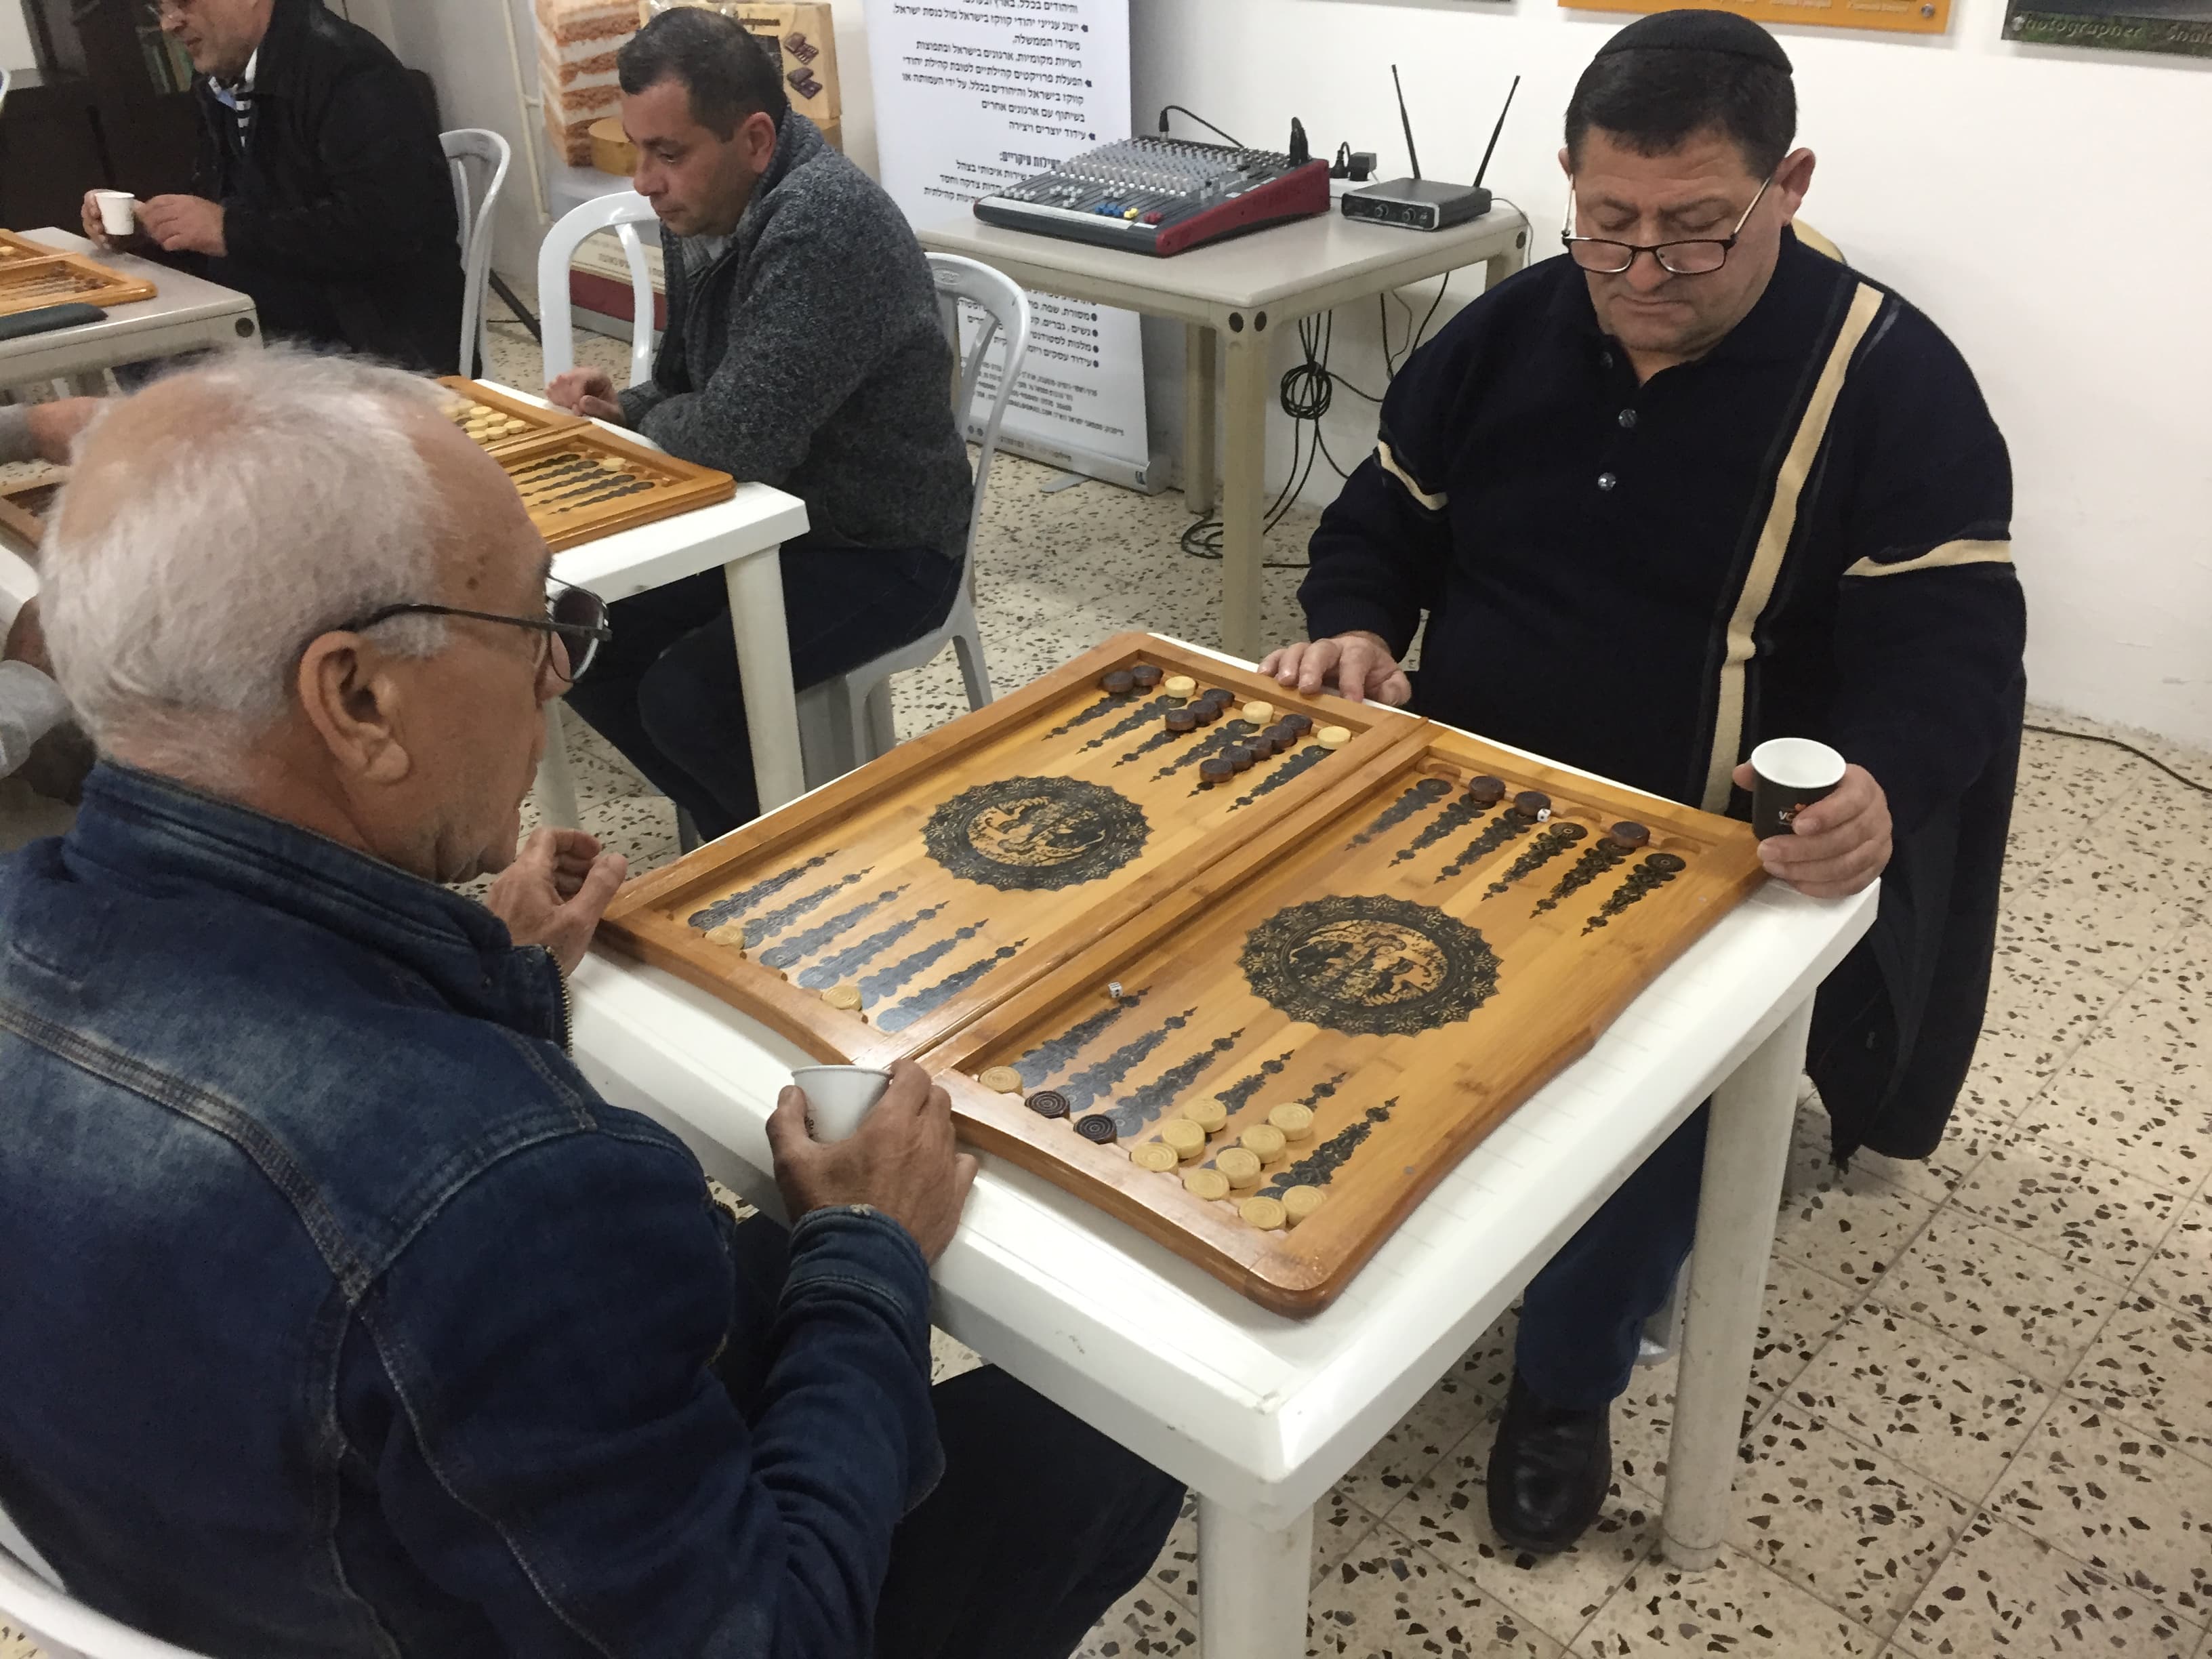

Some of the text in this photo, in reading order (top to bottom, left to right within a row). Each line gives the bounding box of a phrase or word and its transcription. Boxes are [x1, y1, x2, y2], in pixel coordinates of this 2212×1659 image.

[923, 7, 942, 17] כנסת
[943, 7, 957, 19] מול
[959, 9, 989, 22] בישראל
[991, 15, 1012, 26] קווקז
[1015, 18, 1036, 26] יהודי
[2013, 14, 2143, 39] hotographer
[952, 43, 981, 56] בישראל
[1055, 39, 1080, 50] משרדי
[983, 49, 1014, 60] ארגונים
[903, 57, 922, 65] יהודי
[924, 58, 948, 70] קהילת
[950, 62, 973, 72] לטובת
[1055, 58, 1082, 68] רשויות
[902, 73, 912, 81] או
[945, 78, 956, 87] ידי
[1014, 70, 1053, 83] פרויקטים
[956, 77, 967, 89] על
[991, 85, 1026, 97] והיהודים
[1027, 87, 1061, 101] בישראל
[1063, 94, 1084, 106] קווקז
[981, 100, 1085, 122] בשיתוף עם ארגונים אחרים
[1009, 121, 1086, 140] עידוד יוצרים ויצירה
[1071, 325, 1091, 336] נשים
[1071, 355, 1092, 367] עידוד
